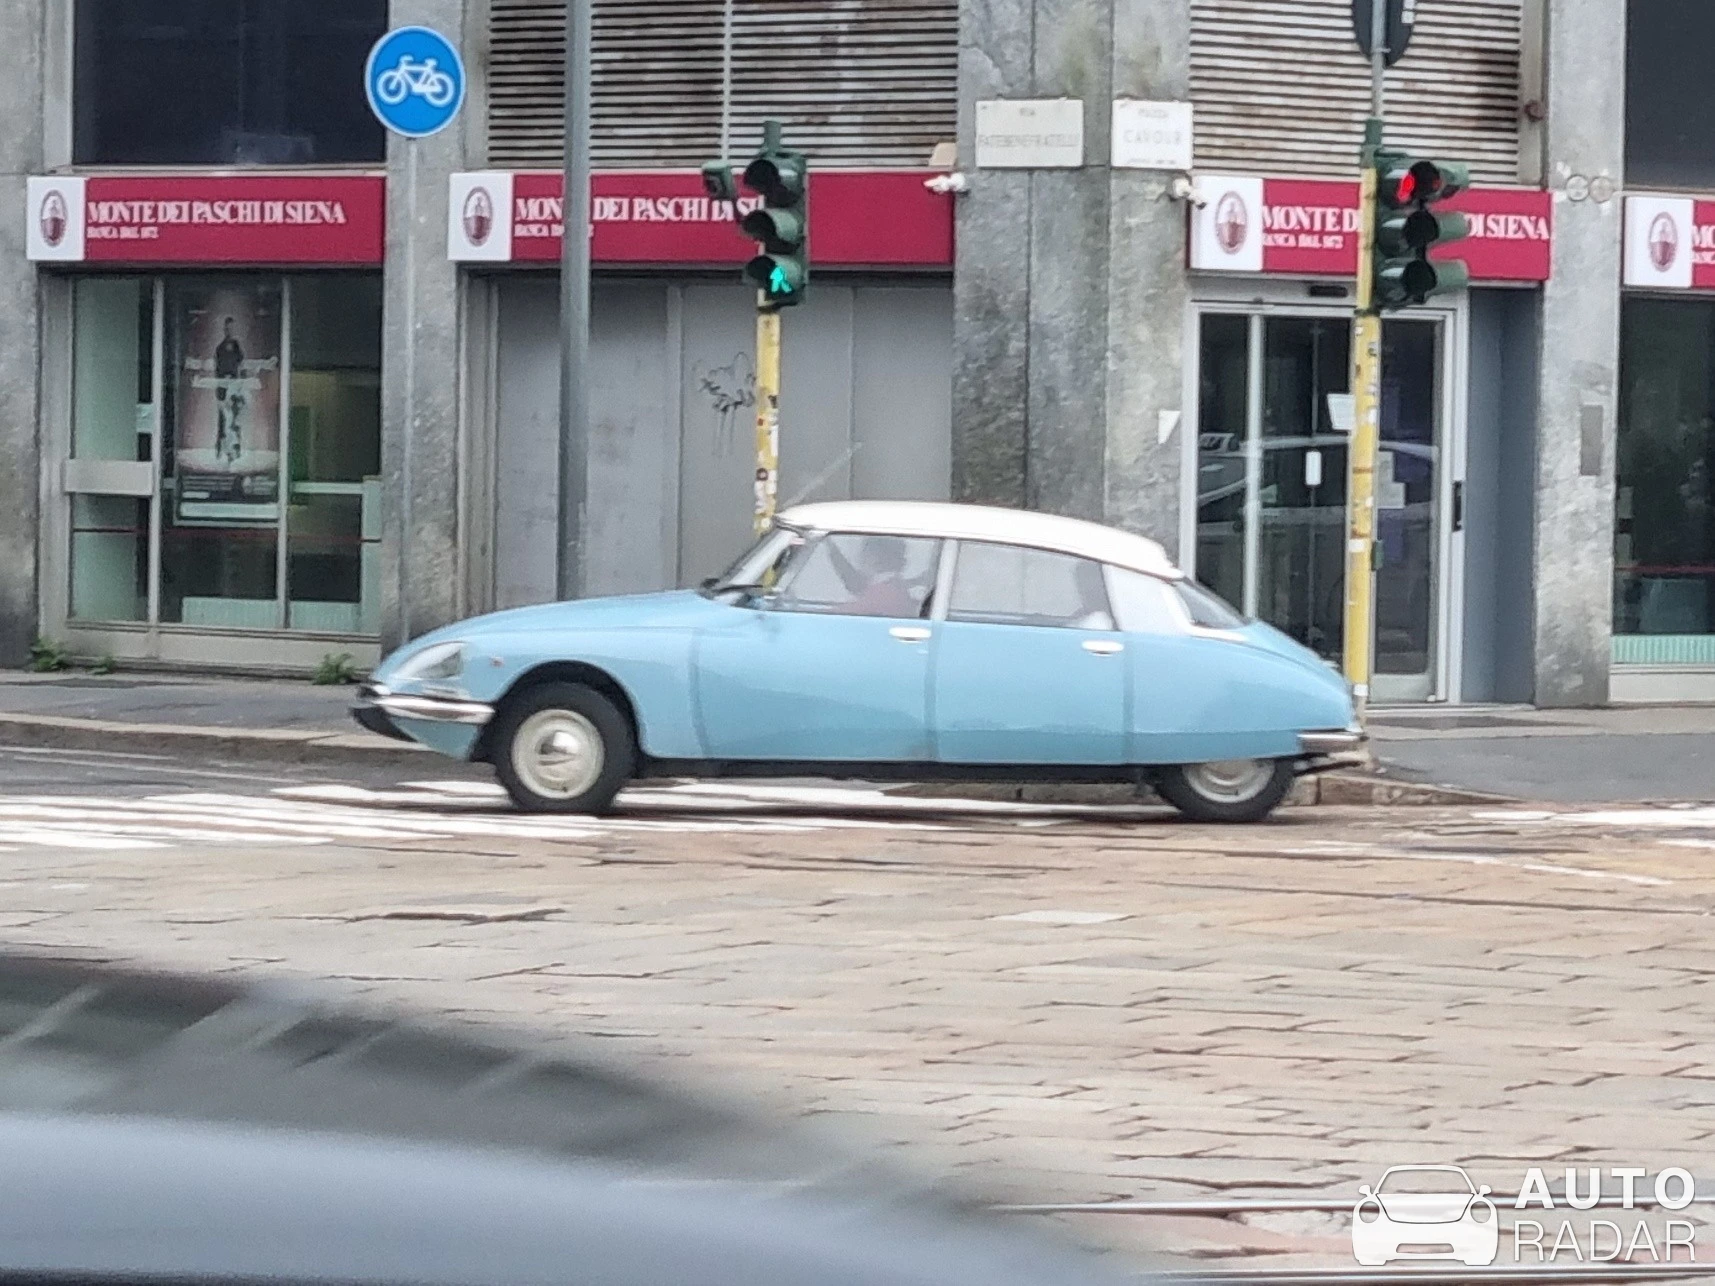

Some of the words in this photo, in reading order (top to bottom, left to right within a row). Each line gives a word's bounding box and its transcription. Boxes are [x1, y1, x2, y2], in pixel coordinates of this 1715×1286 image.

[87, 201, 156, 223] MONTE
[156, 201, 190, 223] DEI
[191, 201, 261, 224] PASCHI
[263, 201, 285, 223] DI
[285, 201, 347, 224] SIENA
[514, 197, 565, 221] MON
[593, 197, 630, 221] DEI
[632, 197, 710, 221] PASCHI
[1262, 205, 1341, 232] MONTE
[1486, 213, 1550, 240] SIENA
